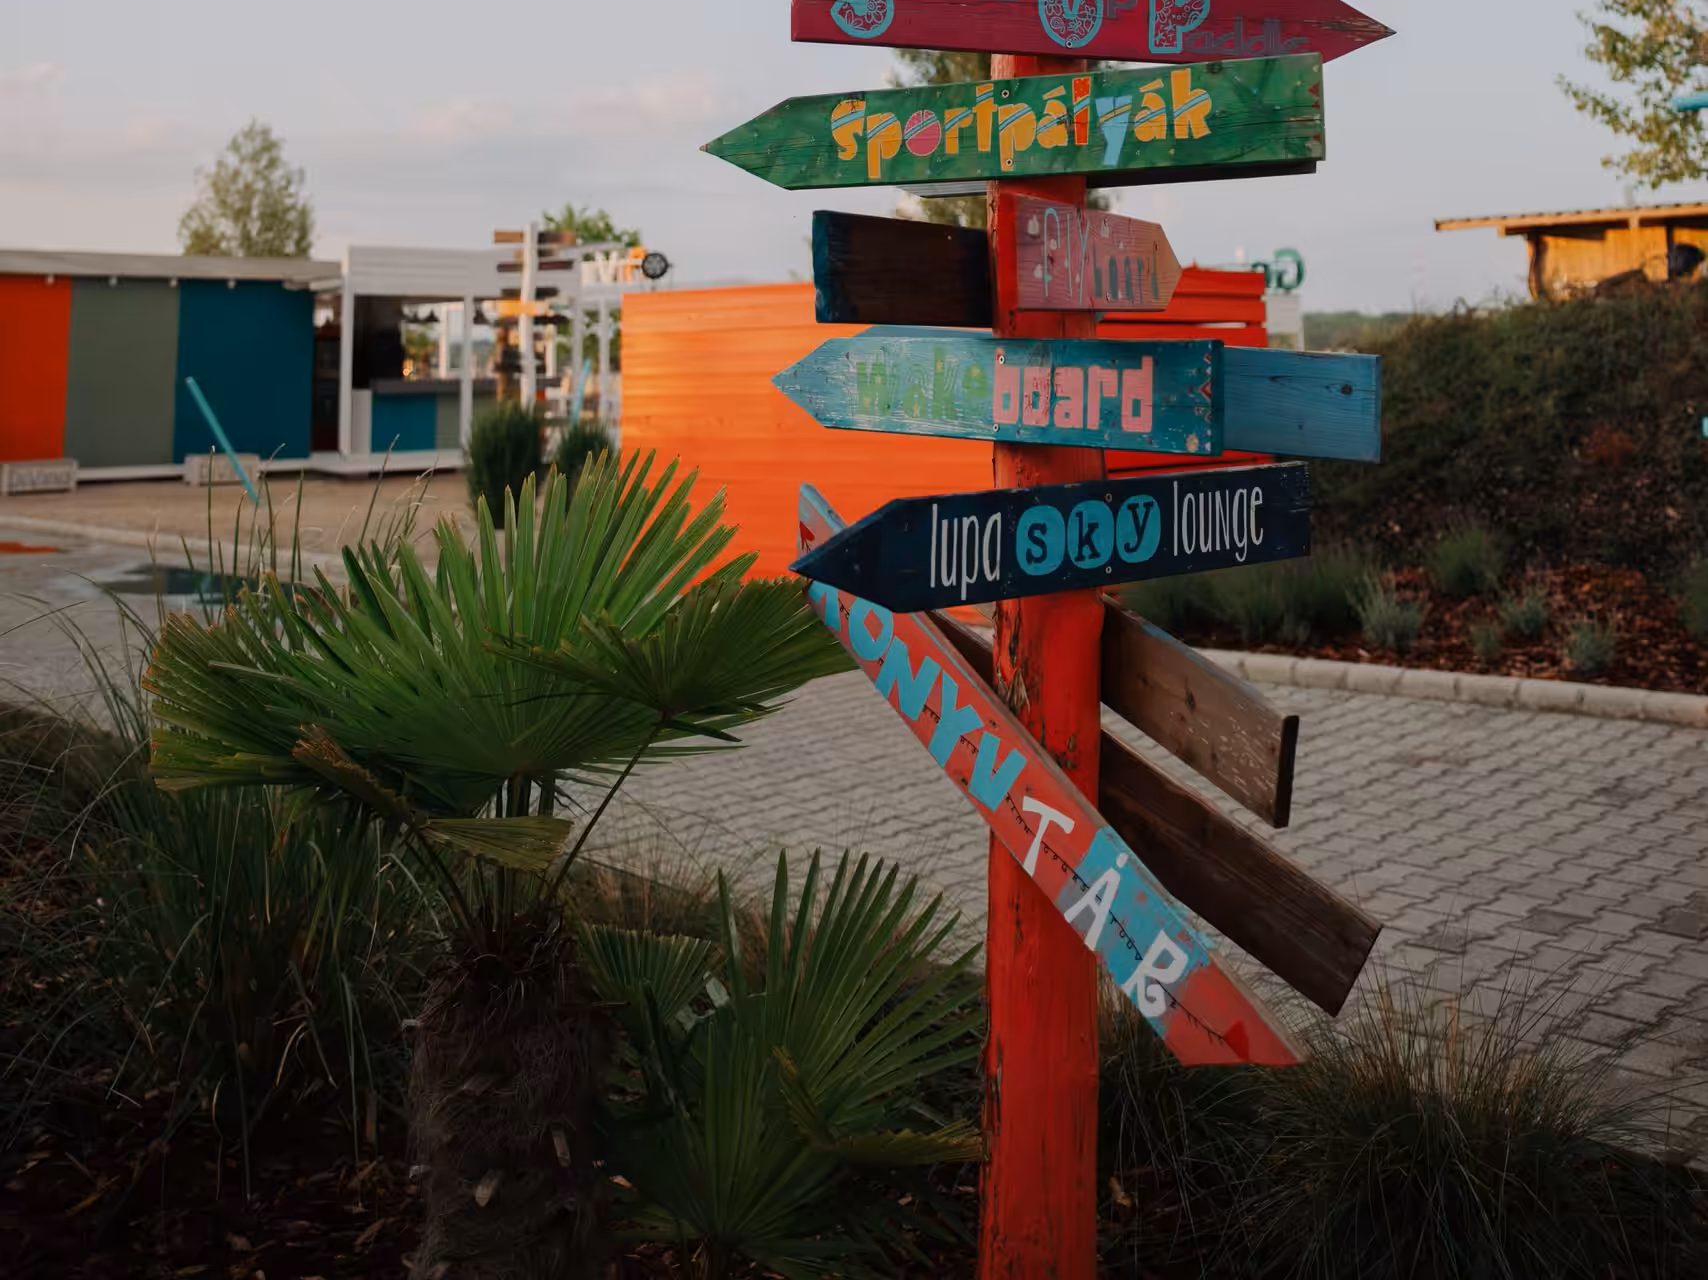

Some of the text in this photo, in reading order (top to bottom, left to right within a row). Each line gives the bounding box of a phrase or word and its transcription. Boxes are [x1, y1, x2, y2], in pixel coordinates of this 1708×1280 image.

[856, 346, 1153, 433] Wakeboard
[930, 503, 1002, 601] lupa
[1022, 496, 1157, 568] sky
